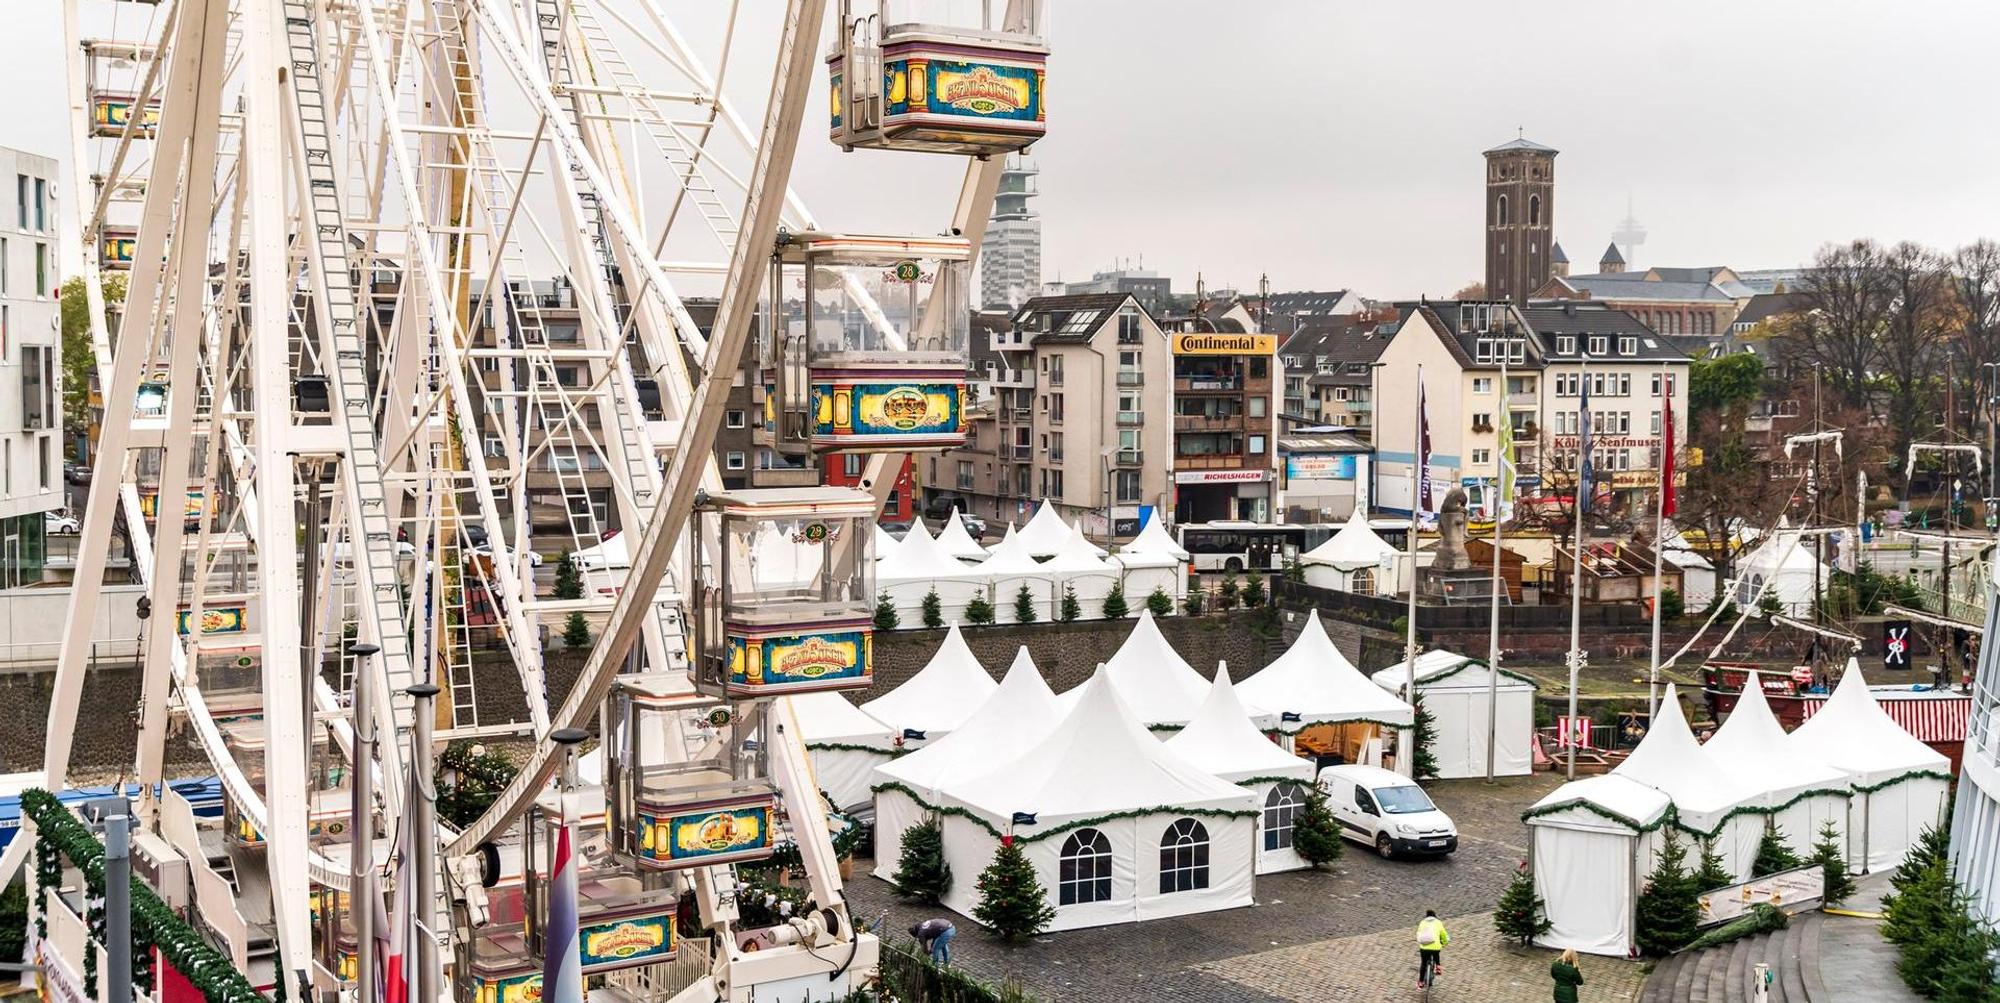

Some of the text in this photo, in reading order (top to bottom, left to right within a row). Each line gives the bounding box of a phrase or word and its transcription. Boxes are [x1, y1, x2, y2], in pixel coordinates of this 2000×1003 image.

[902, 265, 914, 278] 28
[1180, 335, 1255, 352] Continental
[1203, 472, 1261, 480] RICHELSHAGEN
[809, 525, 821, 537] 29
[714, 711, 726, 722] 30
